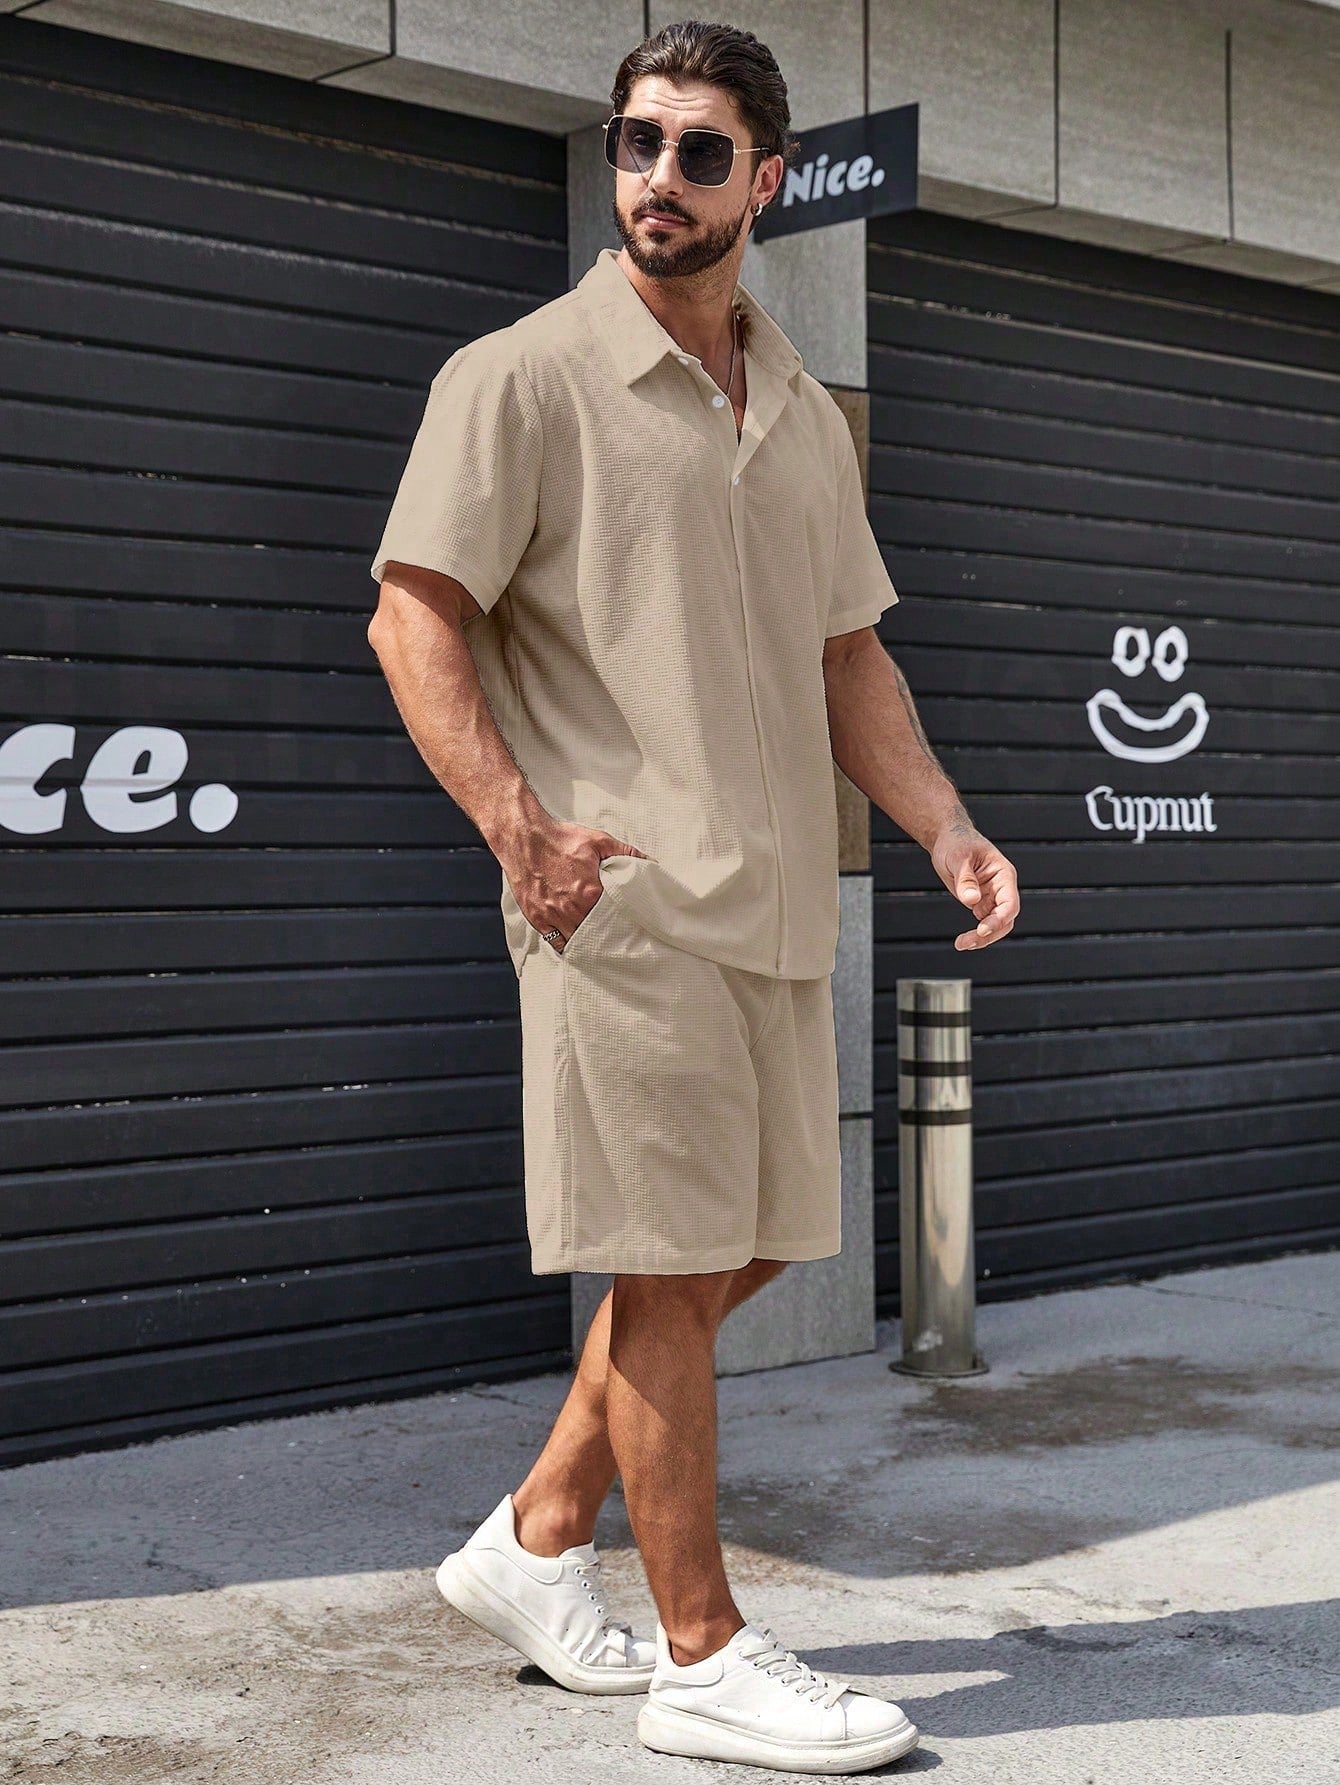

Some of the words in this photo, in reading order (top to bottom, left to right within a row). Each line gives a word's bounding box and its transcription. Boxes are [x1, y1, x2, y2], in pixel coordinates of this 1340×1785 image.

[782, 153, 885, 208] Nice.
[0, 723, 238, 834] ce.
[1085, 785, 1217, 843] Cupnut
